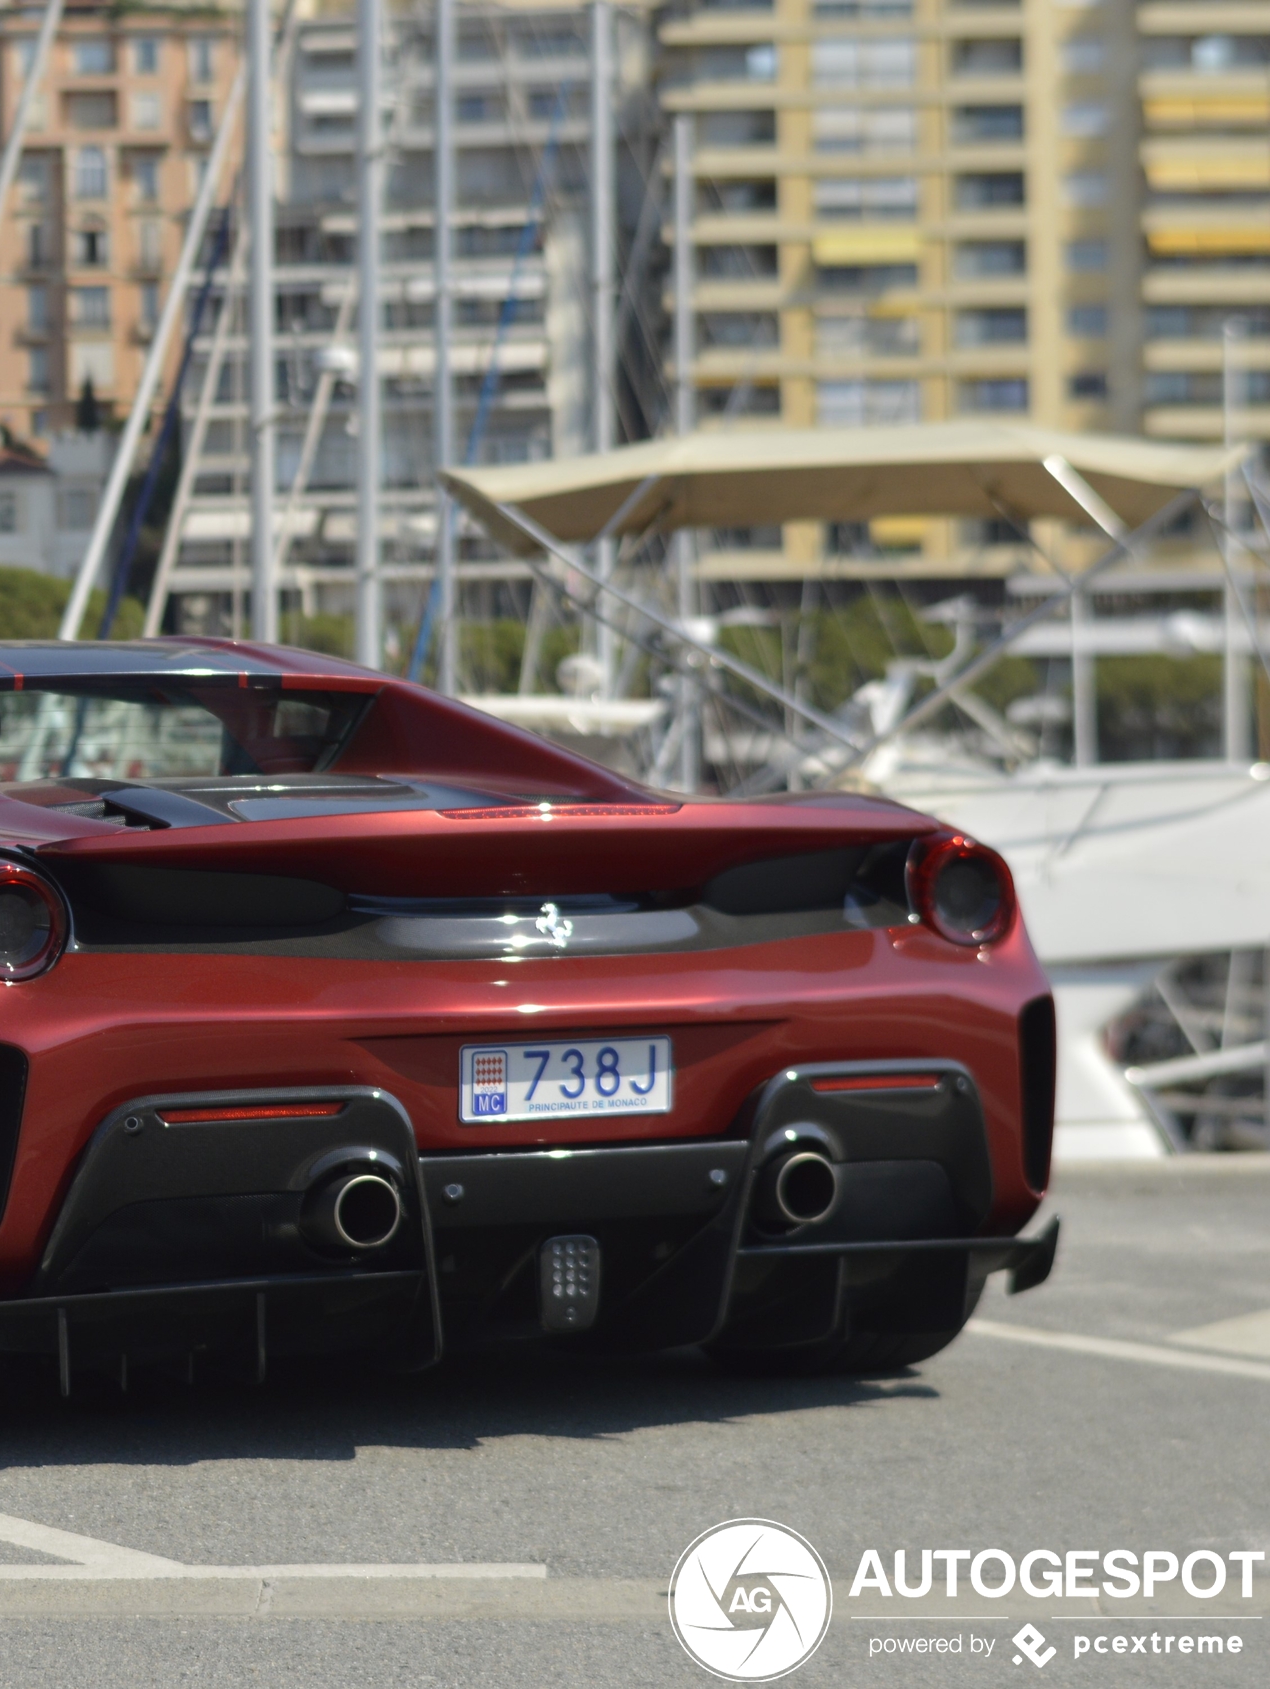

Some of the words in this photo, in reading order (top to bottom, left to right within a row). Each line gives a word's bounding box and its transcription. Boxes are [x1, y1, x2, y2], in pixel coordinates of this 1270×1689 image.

[523, 1044, 656, 1102] 738J
[480, 1086, 498, 1094] 2022
[479, 1095, 500, 1112] MC
[529, 1101, 589, 1112] PRINCIPAUTE
[592, 1100, 605, 1109] DE
[607, 1098, 647, 1108] MONACO
